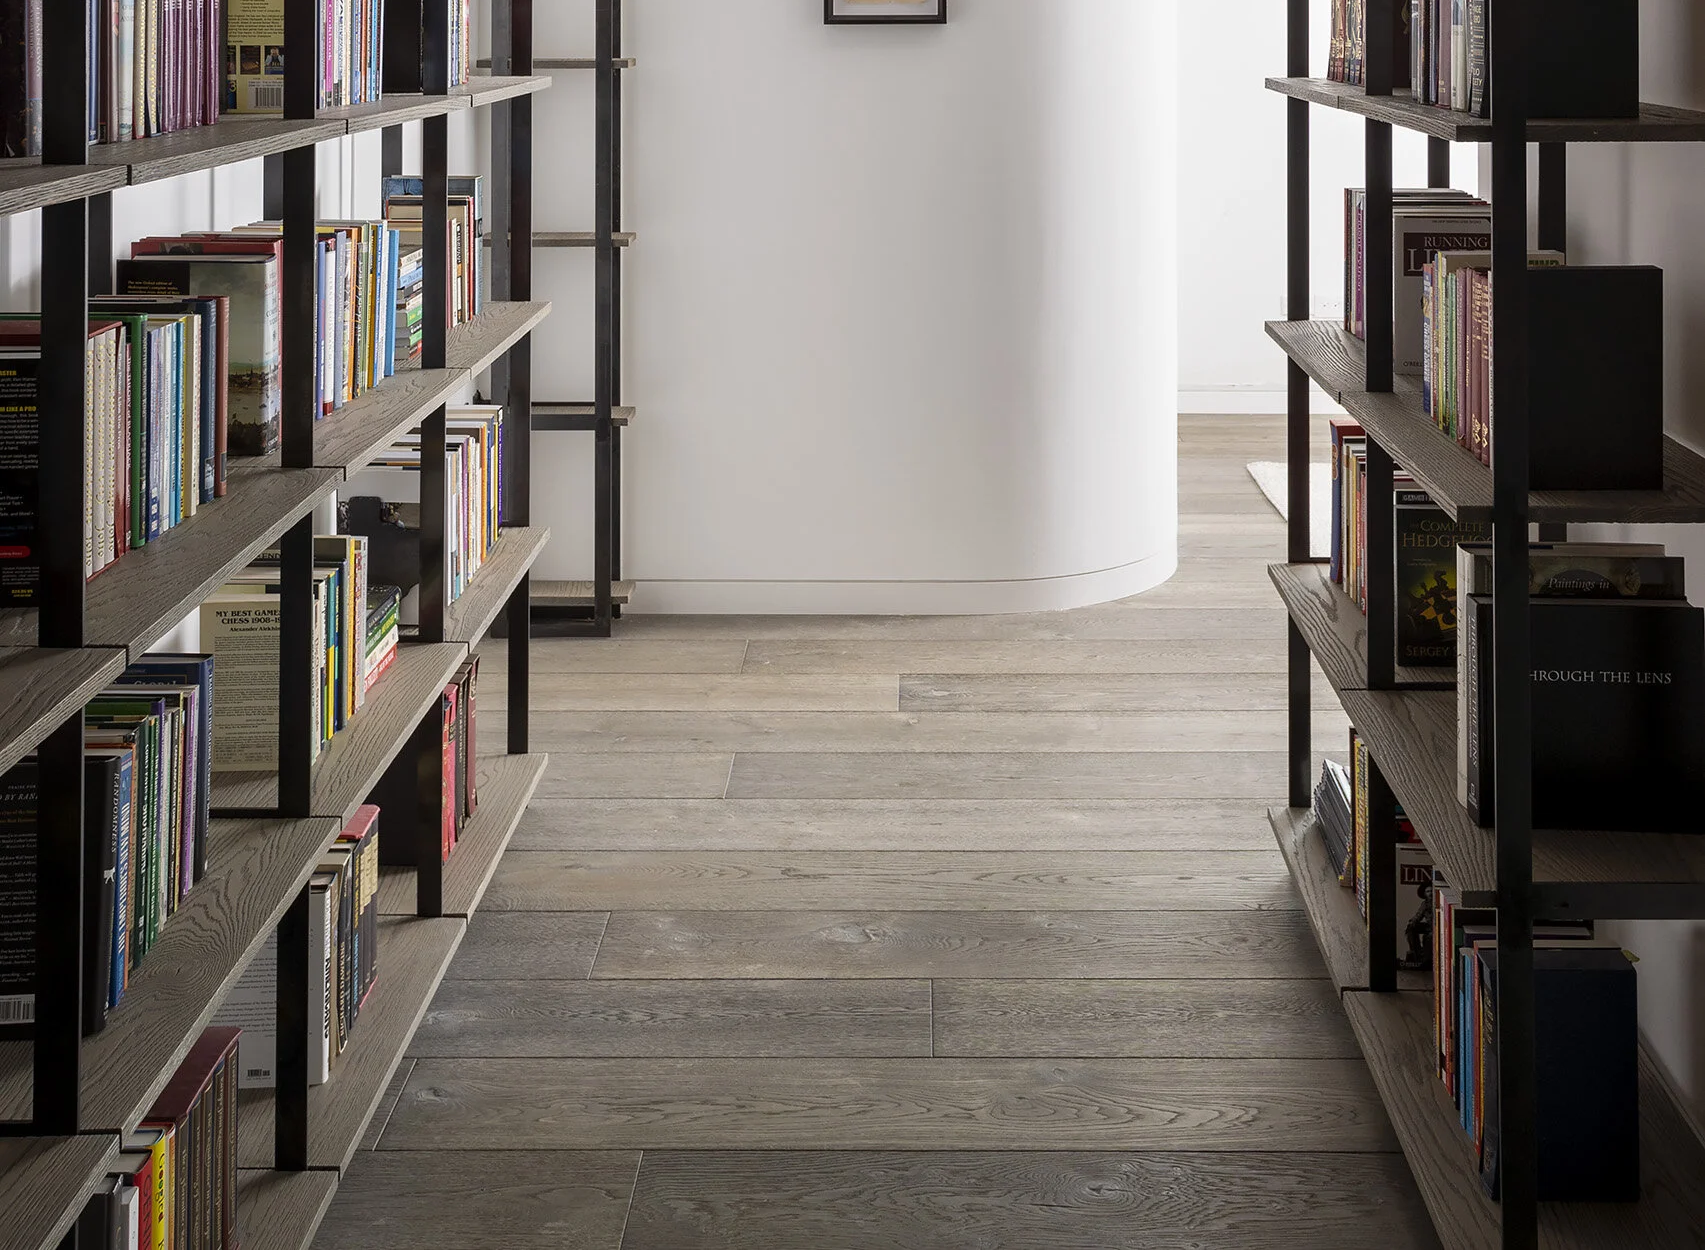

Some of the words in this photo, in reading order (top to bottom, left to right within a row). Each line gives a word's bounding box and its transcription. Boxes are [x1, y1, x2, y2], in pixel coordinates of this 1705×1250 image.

[1423, 236, 1488, 249] RUNNING
[1402, 494, 1432, 502] GAMBI
[1420, 519, 1484, 533] COMPLETE
[1548, 577, 1595, 592] Paintings
[1599, 579, 1610, 590] in
[221, 617, 249, 625] CHESS
[1406, 645, 1448, 658] SERGEY
[1529, 670, 1594, 683] HROUGH
[1600, 671, 1631, 683] THE
[1637, 672, 1672, 685] LENS
[5, 793, 16, 801] BY
[111, 772, 120, 854] RANDOMNESS
[120, 802, 130, 833] MIND
[119, 834, 129, 864] NEW
[118, 864, 128, 932] EMPEROR'S
[117, 933, 125, 954] THE
[156, 1153, 165, 1224] Googled
